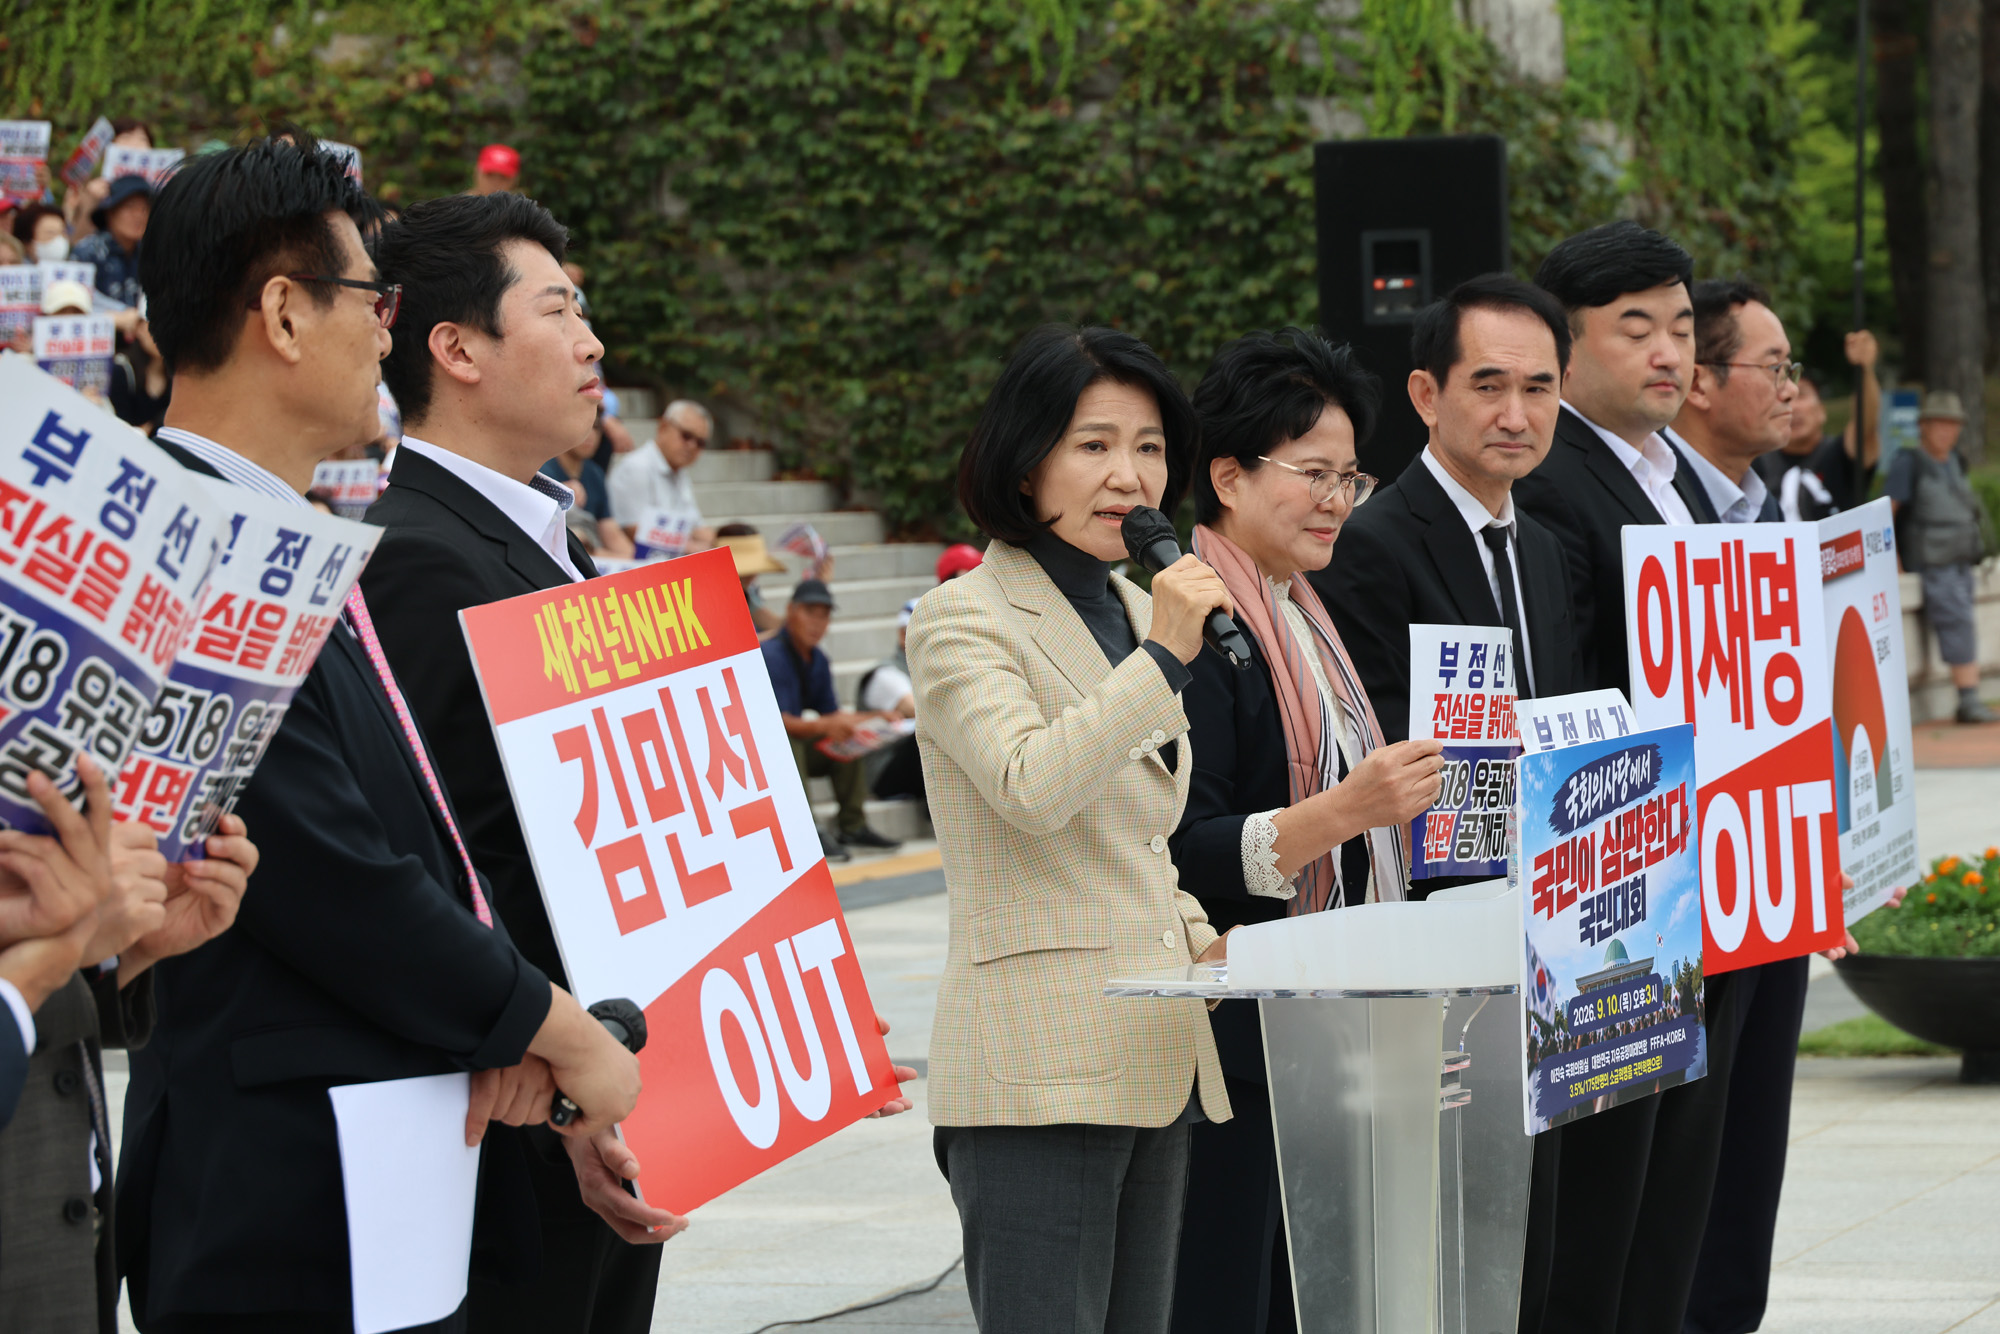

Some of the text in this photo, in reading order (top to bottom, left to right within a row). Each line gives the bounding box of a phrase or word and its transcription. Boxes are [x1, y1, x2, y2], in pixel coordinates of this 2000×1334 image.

[121, 573, 190, 676] 밝혀
[186, 586, 288, 671] 실을
[534, 577, 711, 695] 새천년NHK
[1637, 538, 1804, 737] 이재명
[0, 607, 66, 708] 18
[60, 659, 150, 769] 유공
[139, 683, 231, 764] 518
[1432, 693, 1486, 740] 진실을
[552, 667, 793, 936] 김민석
[1470, 759, 1516, 810] 유공자
[1565, 750, 1651, 830] 국회의사당에서
[1424, 811, 1509, 863] 전면 공개하
[1532, 781, 1690, 921] 국민이 심판한다
[1701, 780, 1833, 953] OUT
[1579, 873, 1646, 947] 국민대회
[700, 917, 873, 1149] OUT
[1573, 1004, 1596, 1027] 2026.
[1650, 1028, 1686, 1051] FFFA-KOREA
